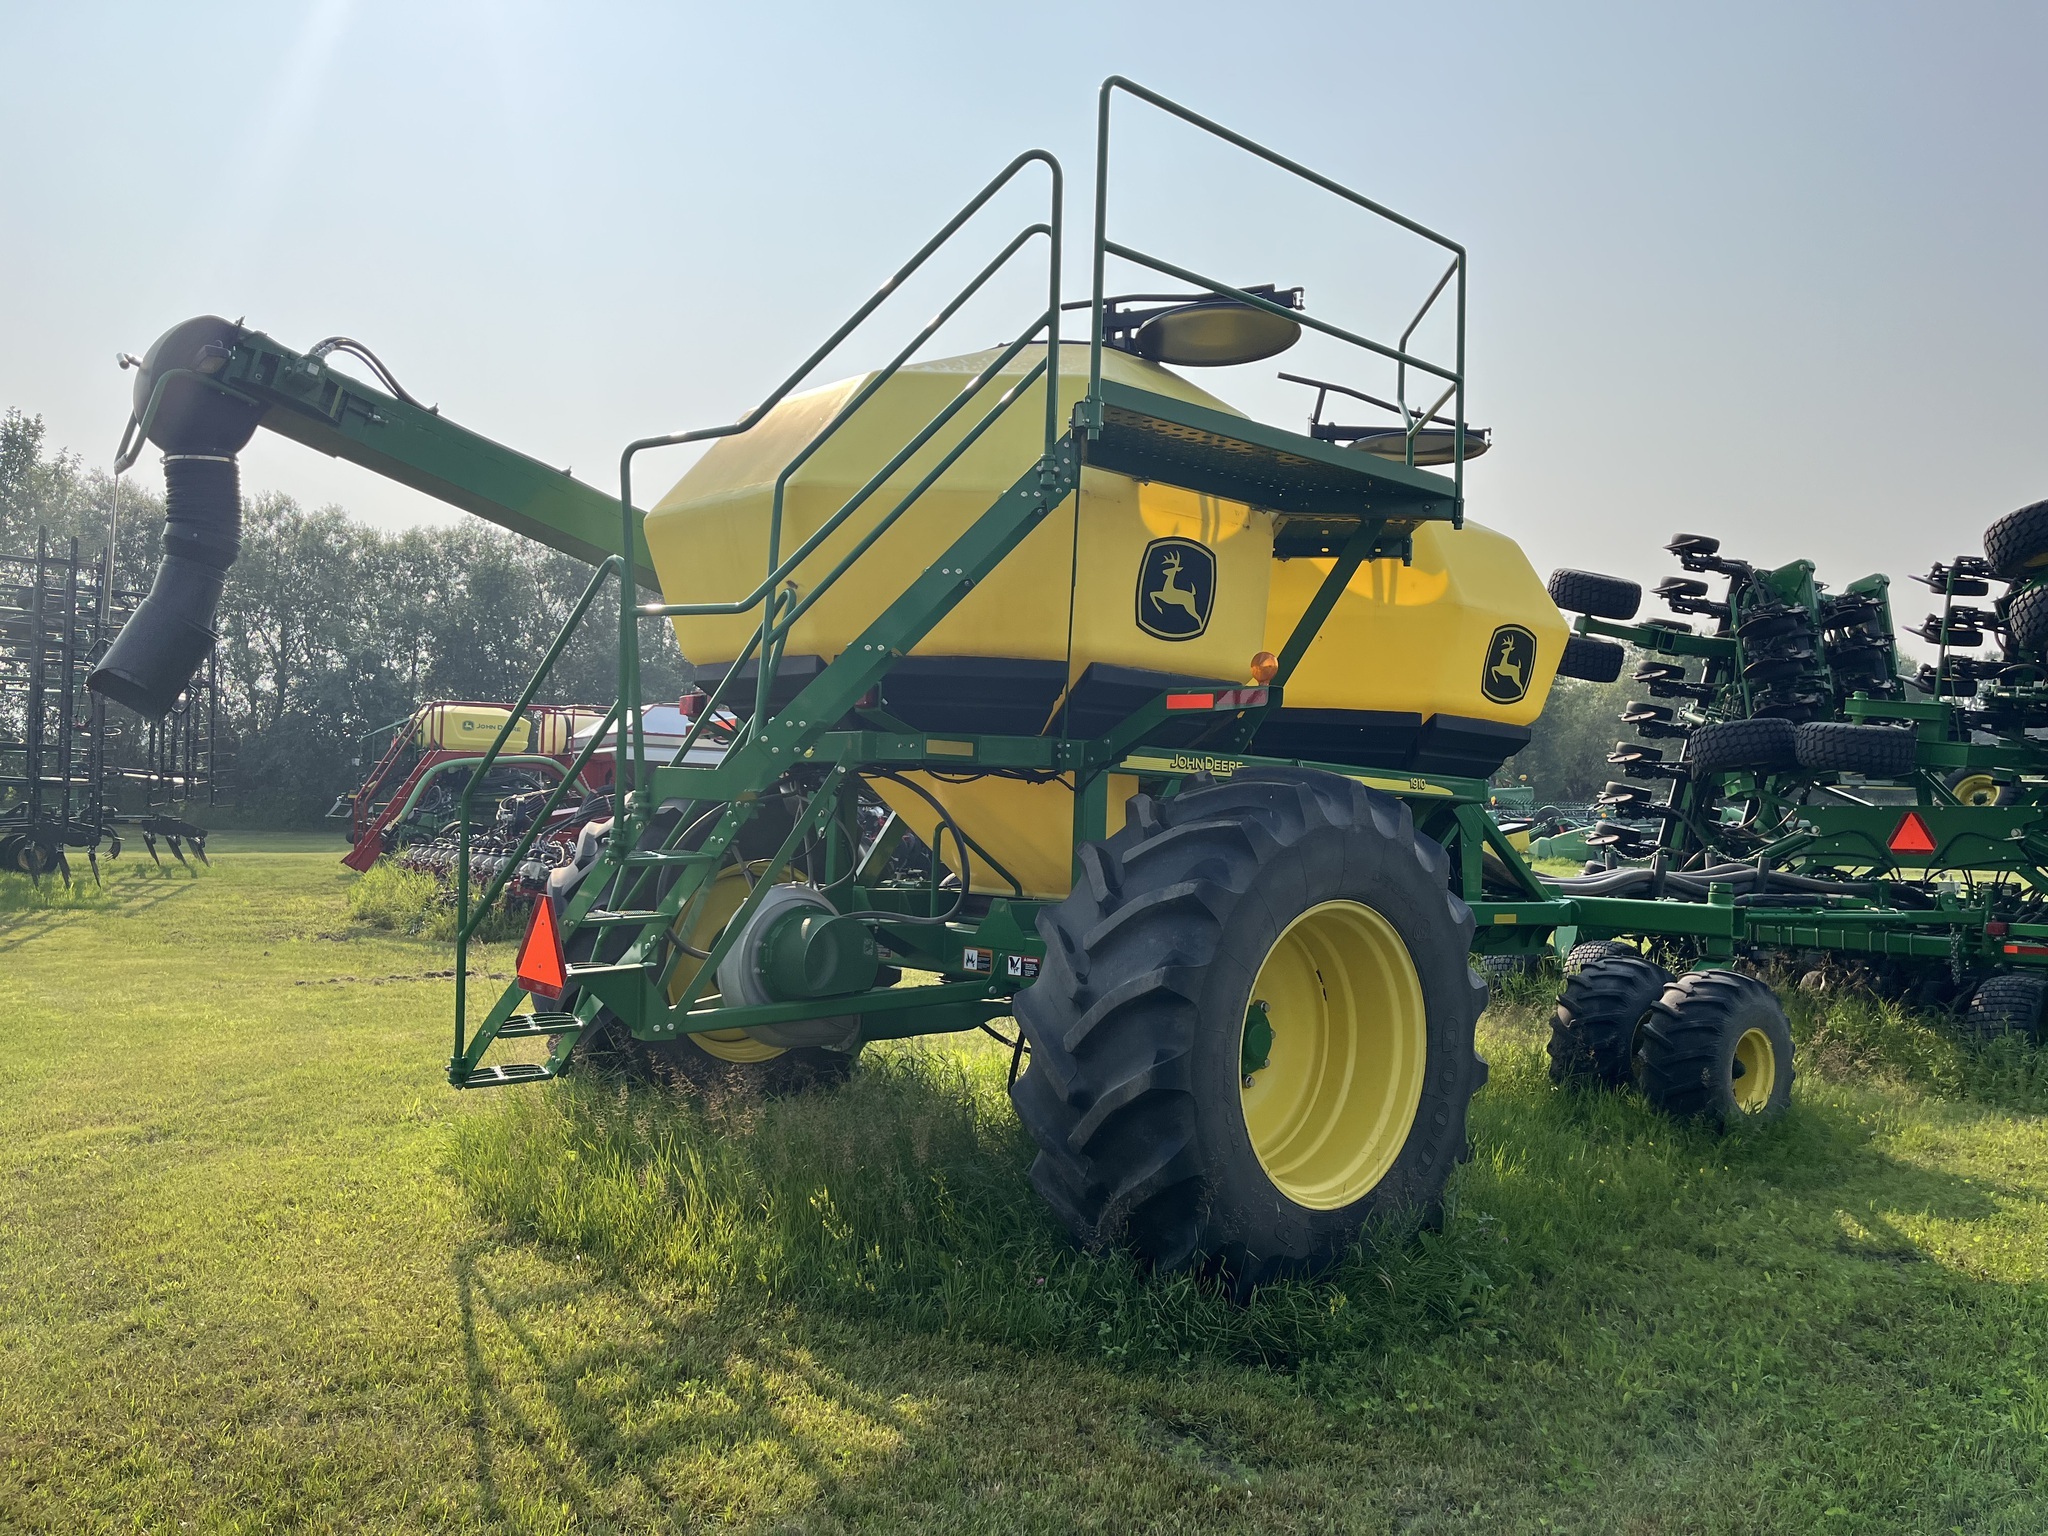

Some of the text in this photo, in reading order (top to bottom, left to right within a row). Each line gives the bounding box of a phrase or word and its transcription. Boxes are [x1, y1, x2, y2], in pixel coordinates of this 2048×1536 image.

[497, 724, 522, 732] DRE
[1170, 753, 1204, 771] JOHN
[1410, 777, 1426, 790] 1910
[1416, 1014, 1460, 1176] GOOD
